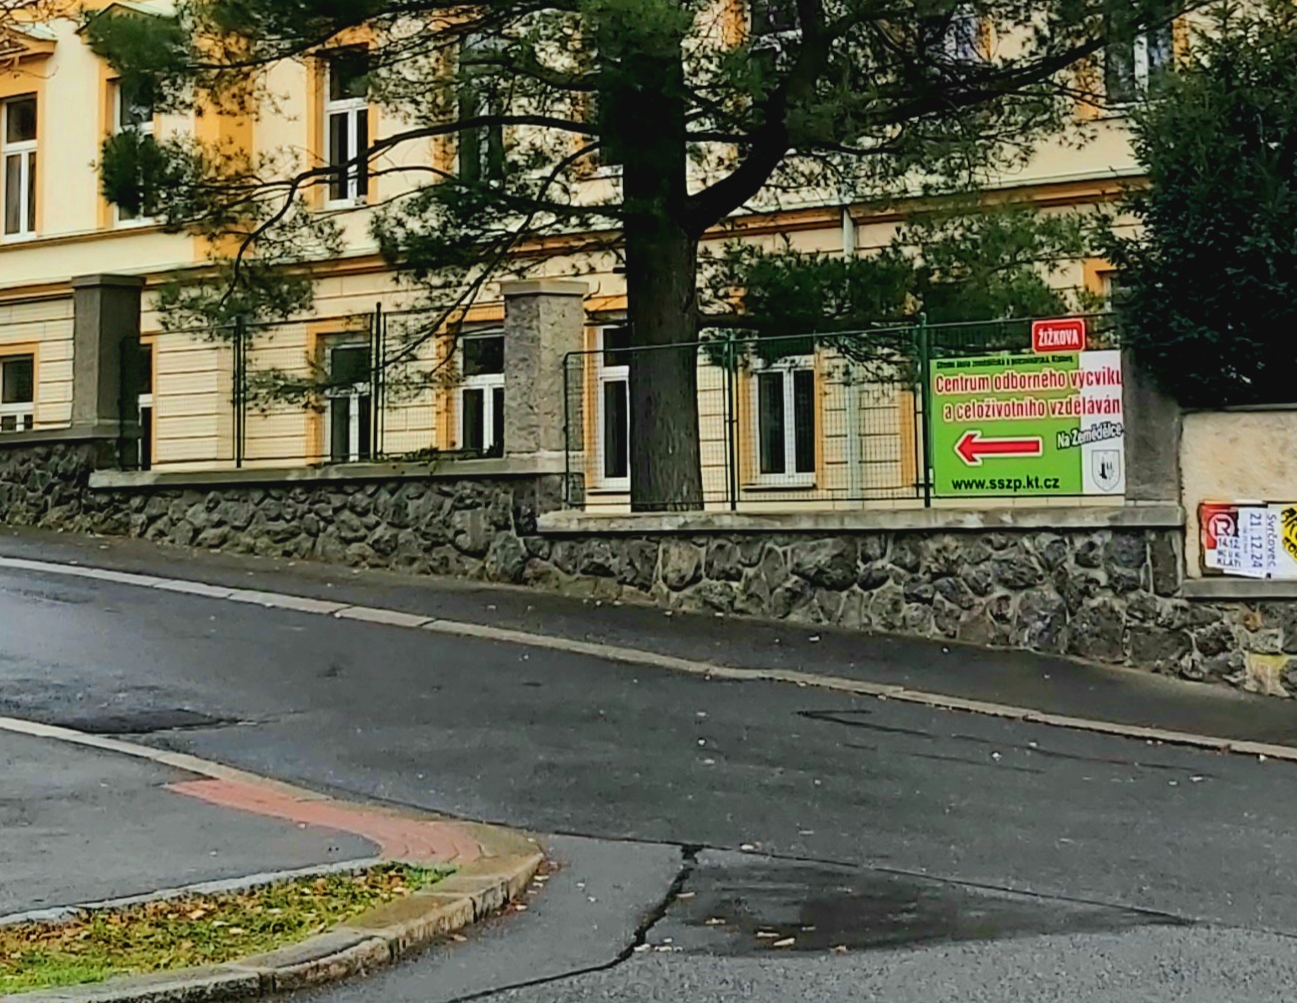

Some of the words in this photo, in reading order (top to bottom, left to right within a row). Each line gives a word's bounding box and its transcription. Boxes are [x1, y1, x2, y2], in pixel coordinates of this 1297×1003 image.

[1037, 327, 1080, 347] ŽIŽKOVA
[935, 375, 990, 393] Centrum
[994, 368, 1066, 390] odborného
[944, 404, 952, 419] a
[956, 398, 1046, 420] celoživotního
[1057, 431, 1071, 450] Na
[951, 474, 1060, 492] www.sszp.kt.cz
